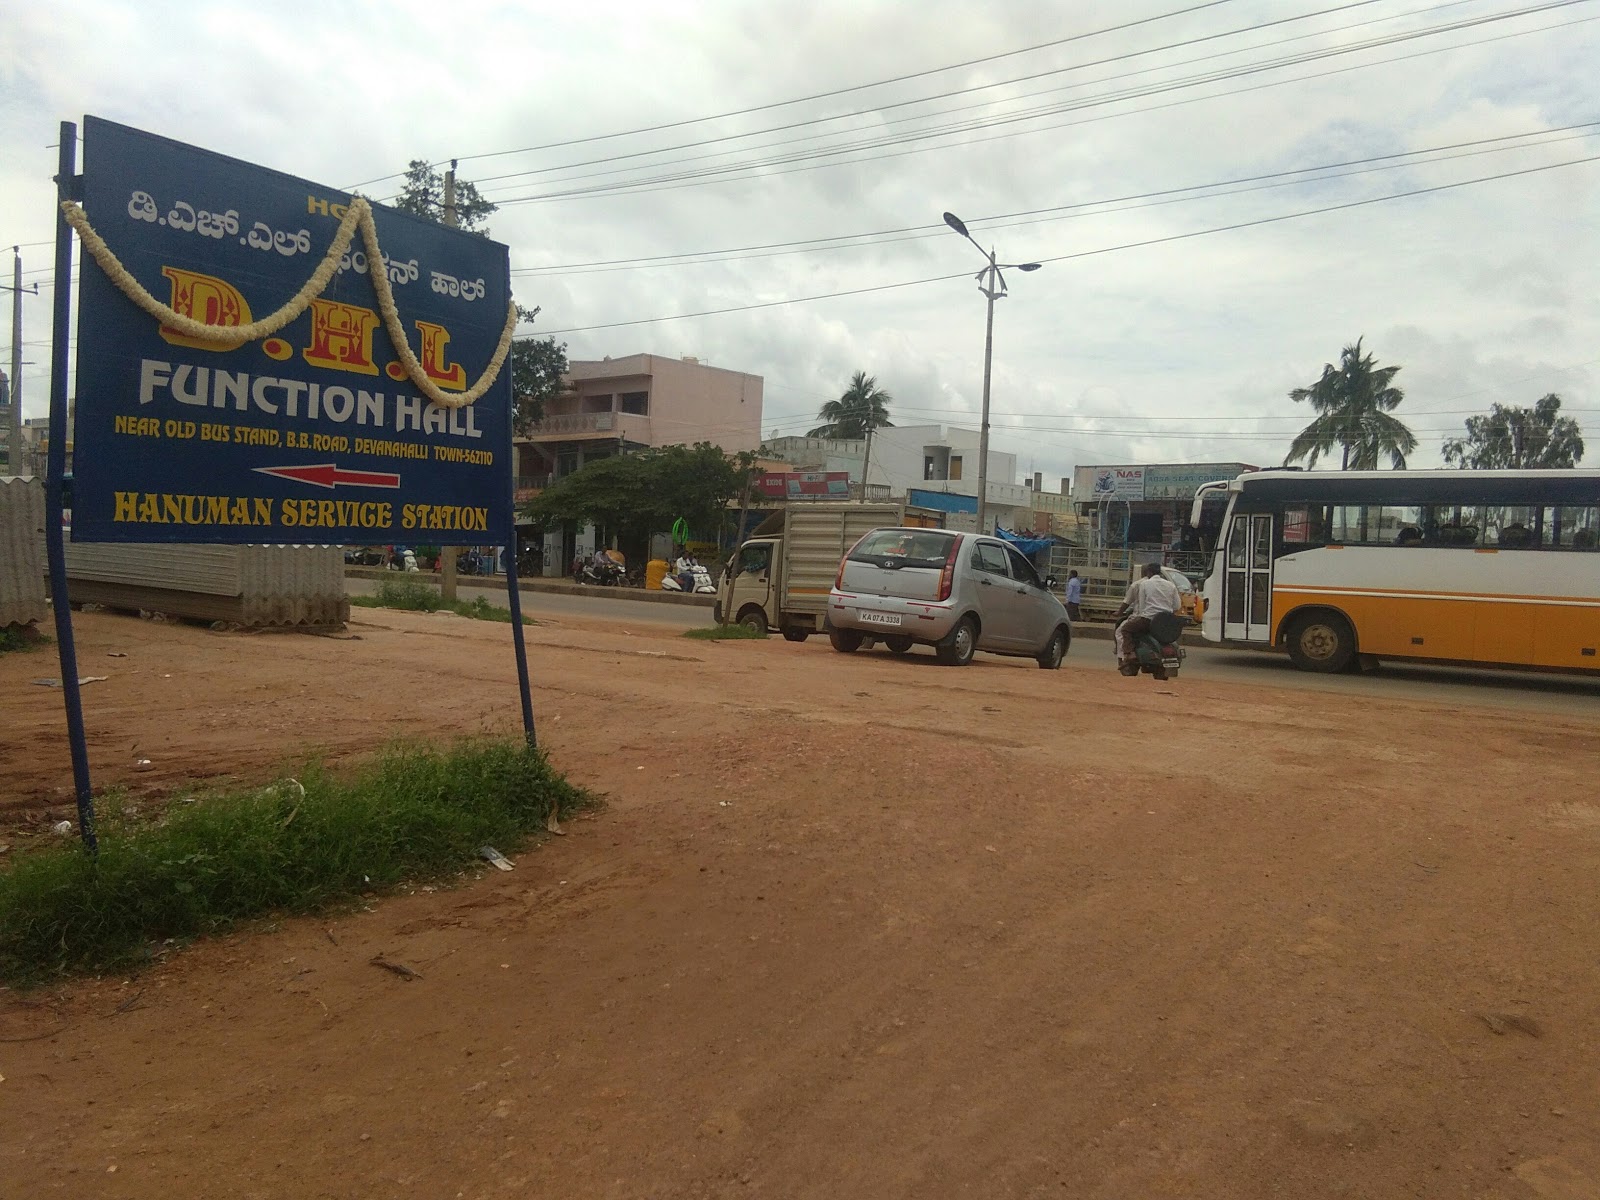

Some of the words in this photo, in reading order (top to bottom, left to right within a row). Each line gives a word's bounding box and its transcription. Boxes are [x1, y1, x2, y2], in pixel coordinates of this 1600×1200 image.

[430, 270, 486, 302] ಹಾಲ್
[139, 358, 385, 428] FUNCTION
[396, 394, 482, 439] HALL
[114, 415, 161, 438] NEAR
[165, 419, 197, 439] OLD
[200, 422, 231, 443] BUS
[234, 426, 284, 448] STAND,
[354, 437, 429, 460] DEVANAHALLI
[113, 491, 274, 527] HANUMAN
[280, 498, 394, 529] SERVICE
[402, 503, 489, 532] STATION
